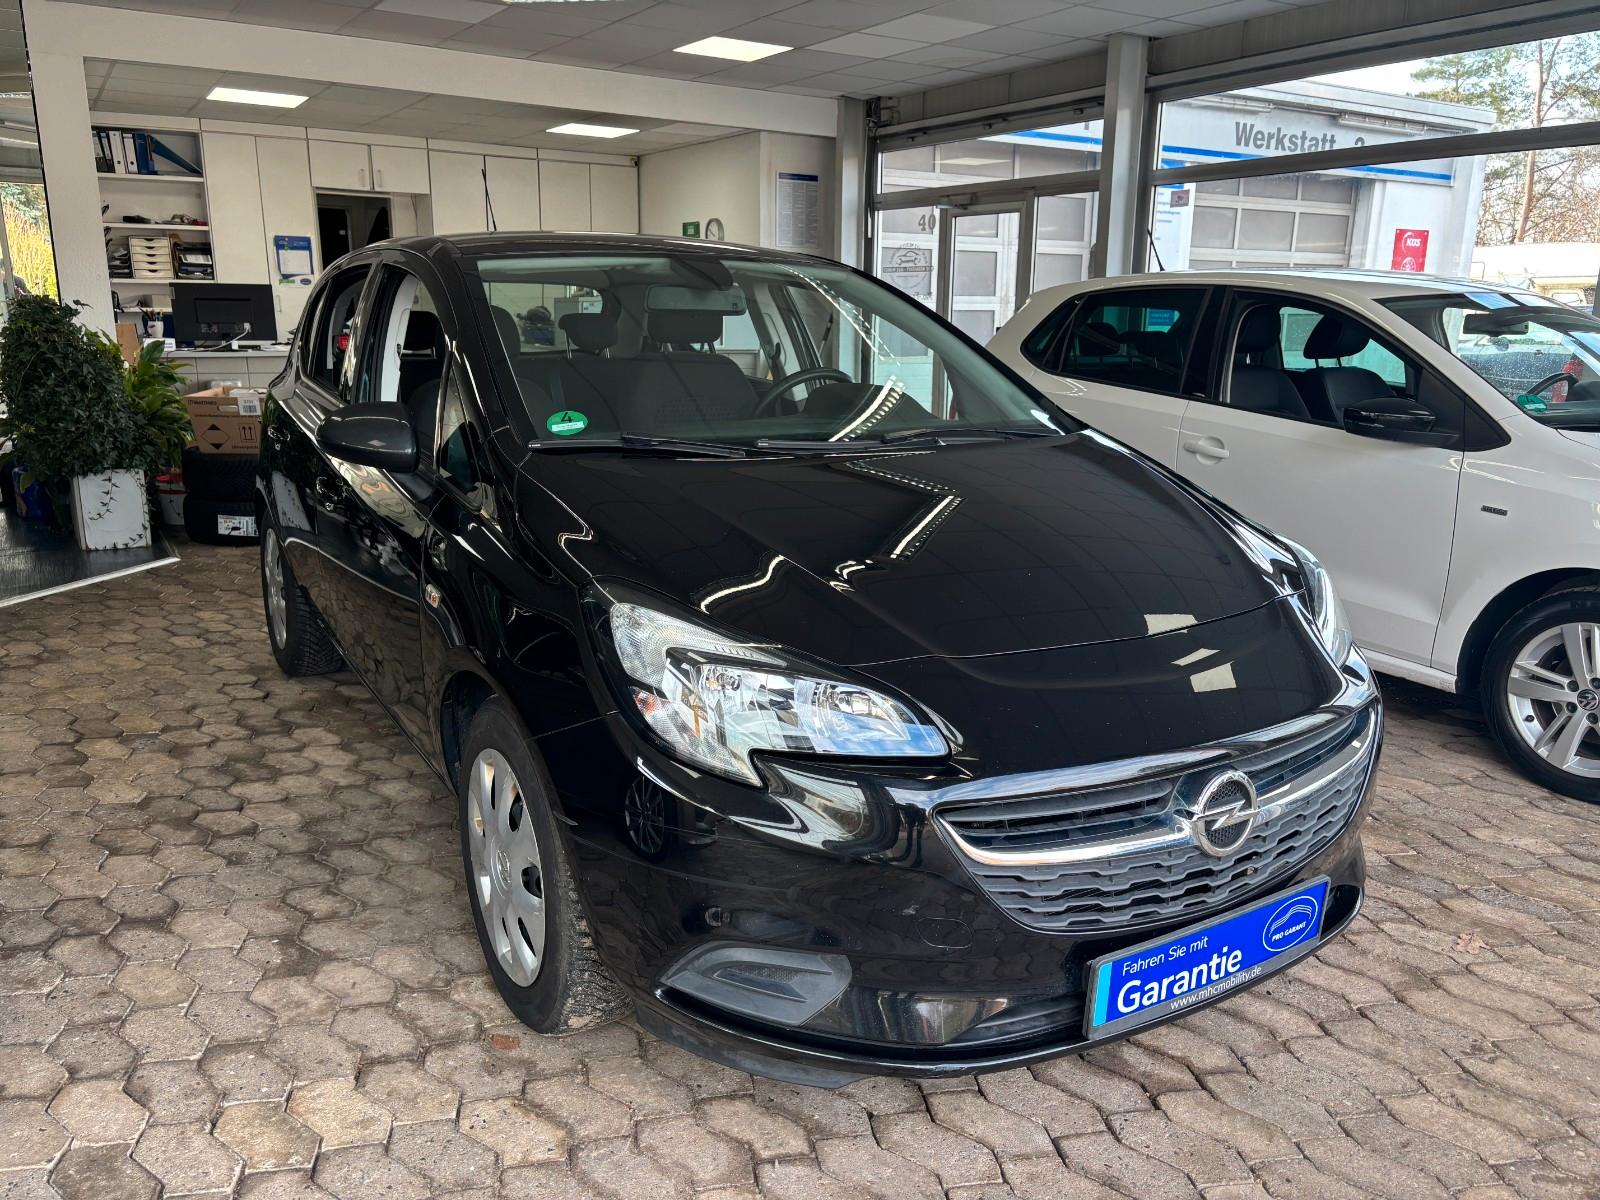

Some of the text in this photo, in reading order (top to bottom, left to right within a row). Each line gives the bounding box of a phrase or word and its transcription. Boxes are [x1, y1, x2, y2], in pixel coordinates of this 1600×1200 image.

[1235, 121, 1336, 152] Werkstatt
[918, 214, 936, 231] 40
[561, 411, 572, 423] 4
[1271, 921, 1307, 943] PRO GARANT
[1122, 936, 1209, 976] Fahren Sie mit
[1116, 945, 1243, 1014] Garantie
[1170, 966, 1262, 1011] www.mhcmobility.de
